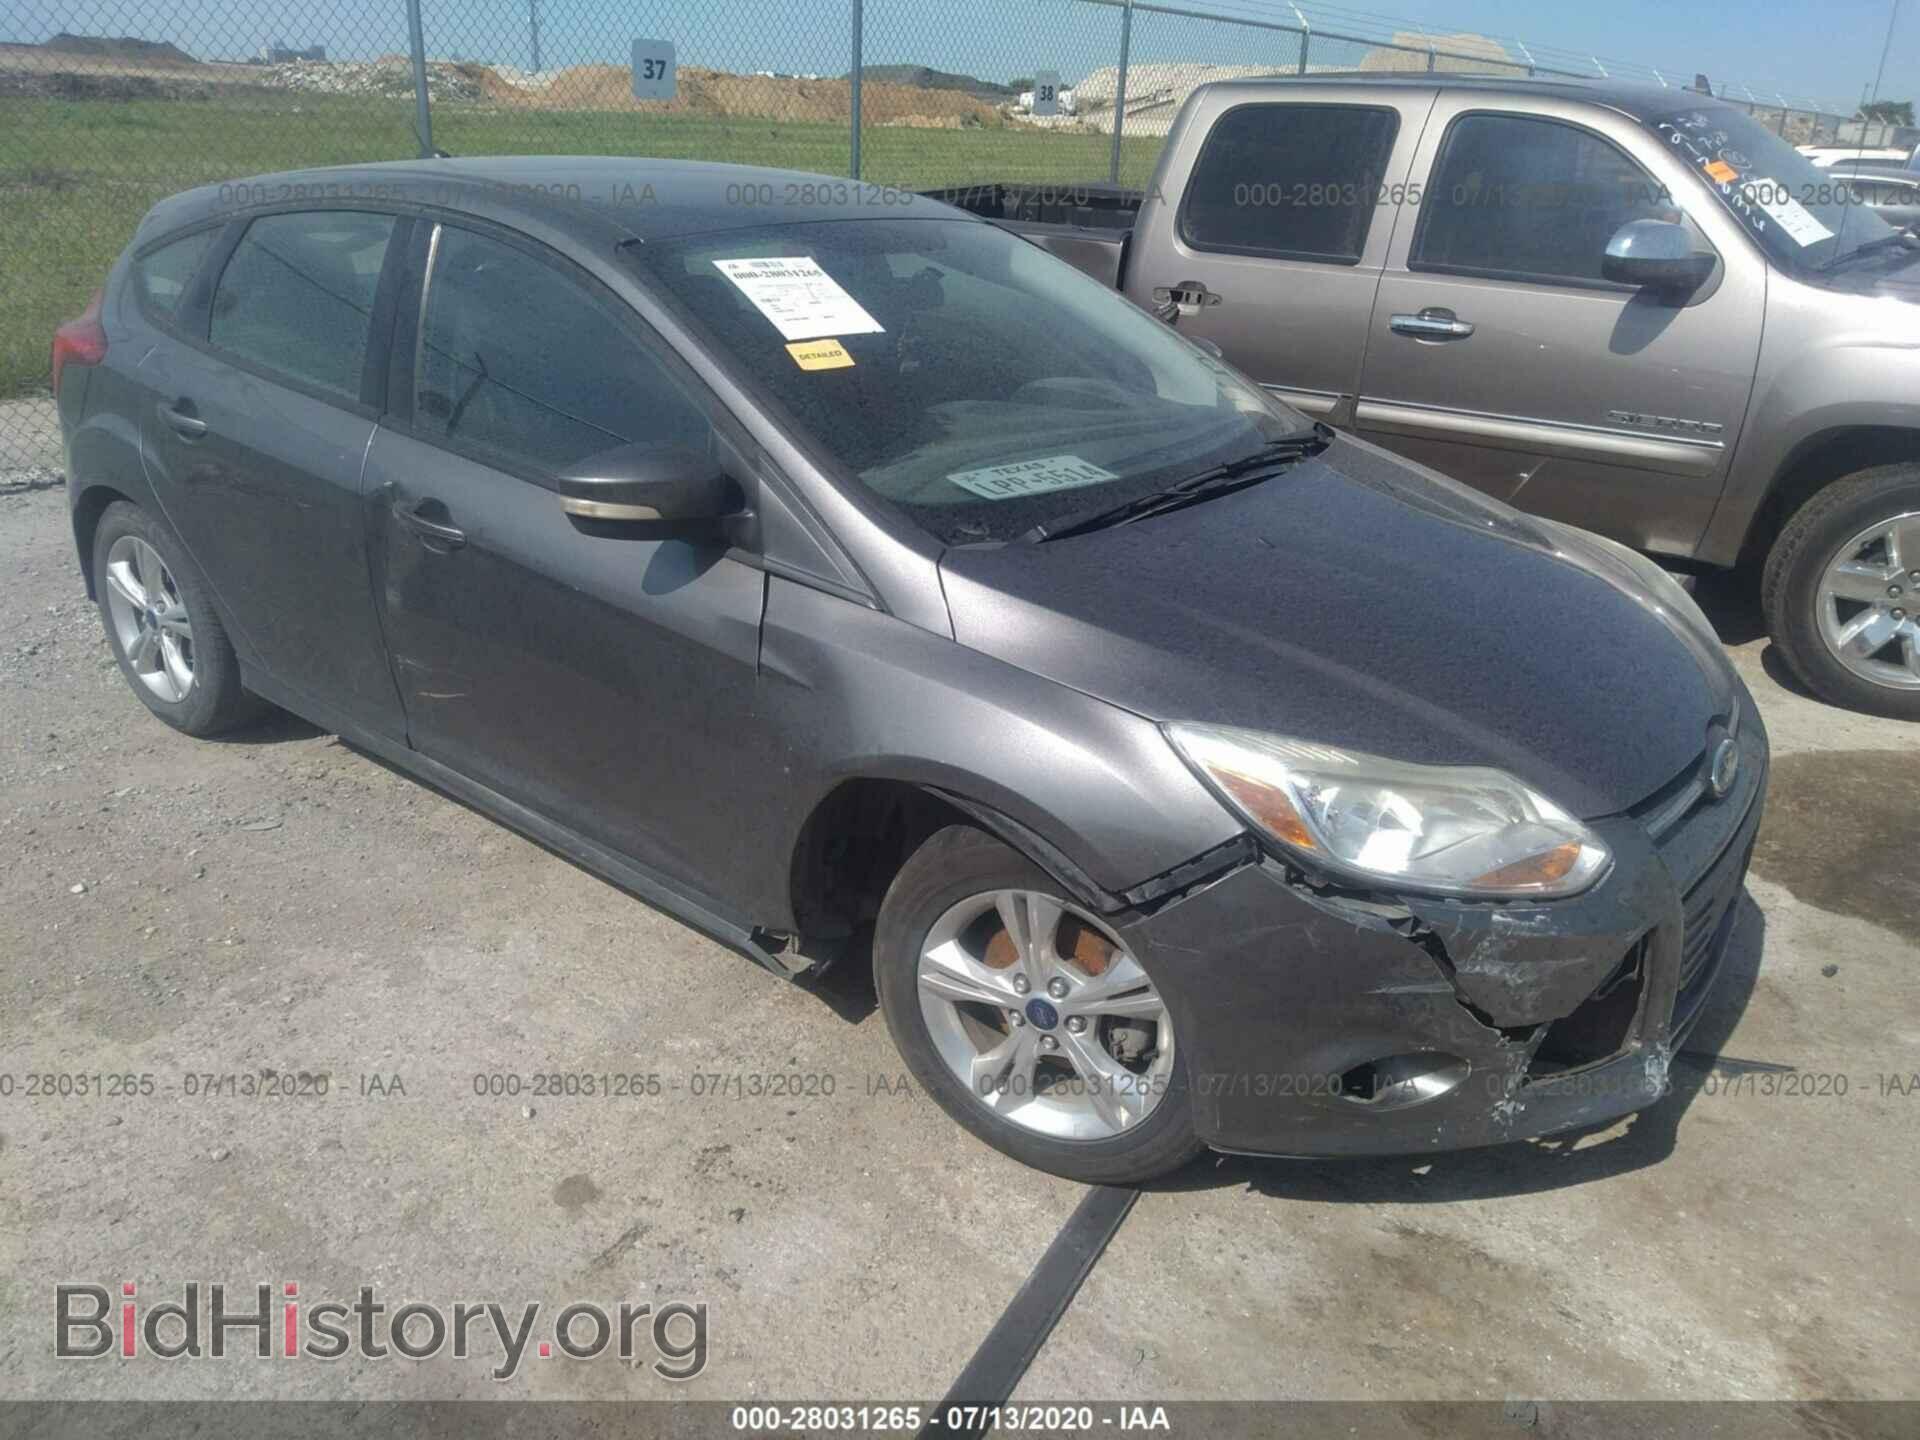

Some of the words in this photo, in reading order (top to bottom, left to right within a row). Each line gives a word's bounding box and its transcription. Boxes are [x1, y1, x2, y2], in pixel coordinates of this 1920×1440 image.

[642, 58, 667, 81] 37
[1040, 85, 1054, 102] 38
[798, 350, 843, 361] DETAILED
[991, 462, 1048, 477] TEXAS
